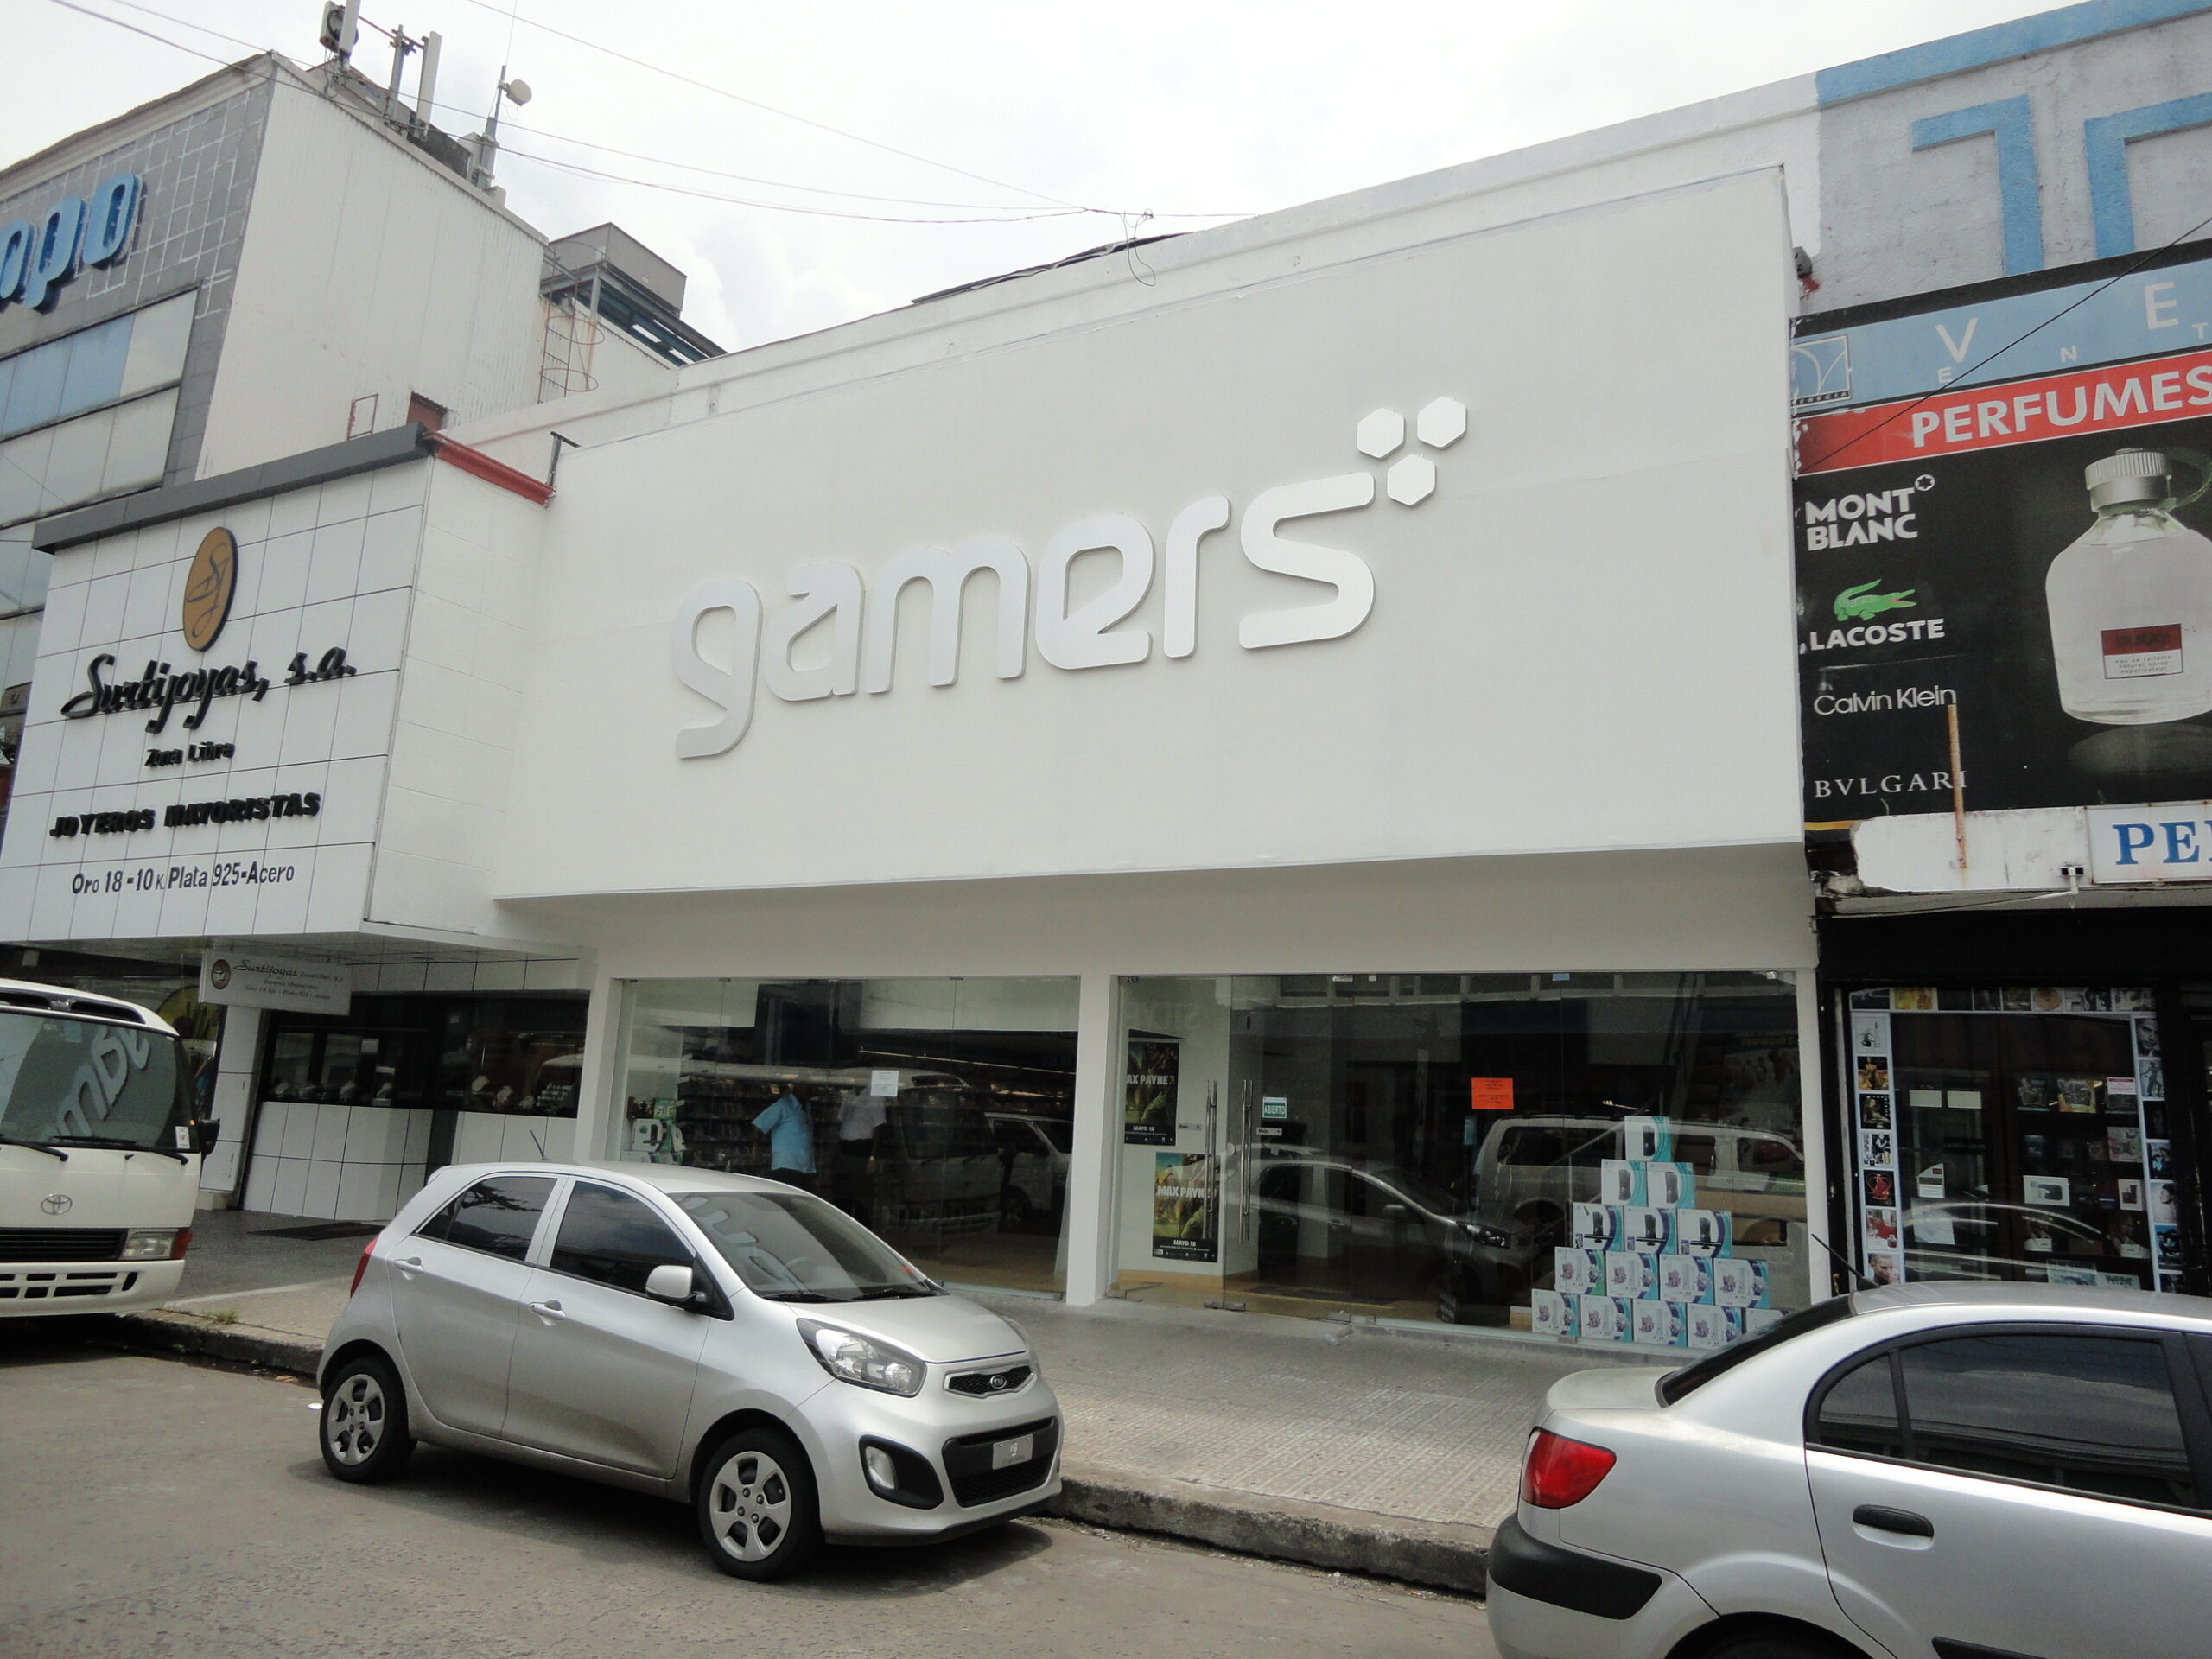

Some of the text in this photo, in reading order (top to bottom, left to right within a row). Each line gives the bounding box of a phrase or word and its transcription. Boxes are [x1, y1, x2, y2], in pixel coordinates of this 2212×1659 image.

[1911, 365, 2212, 448] PERFUMES
[1805, 486, 1915, 525] MONT
[1807, 514, 1918, 551] BLANC
[672, 471, 1376, 760] gamers
[1810, 618, 1946, 651] LACOSTE
[1814, 685, 1957, 715] Calvin Klein
[49, 792, 321, 838] JOYEROS MAYORISTAS
[72, 873, 100, 894] Oro
[168, 866, 207, 890] Plata
[1140, 1074, 1168, 1085] PAYNE
[1156, 1185, 1179, 1197] MAX
